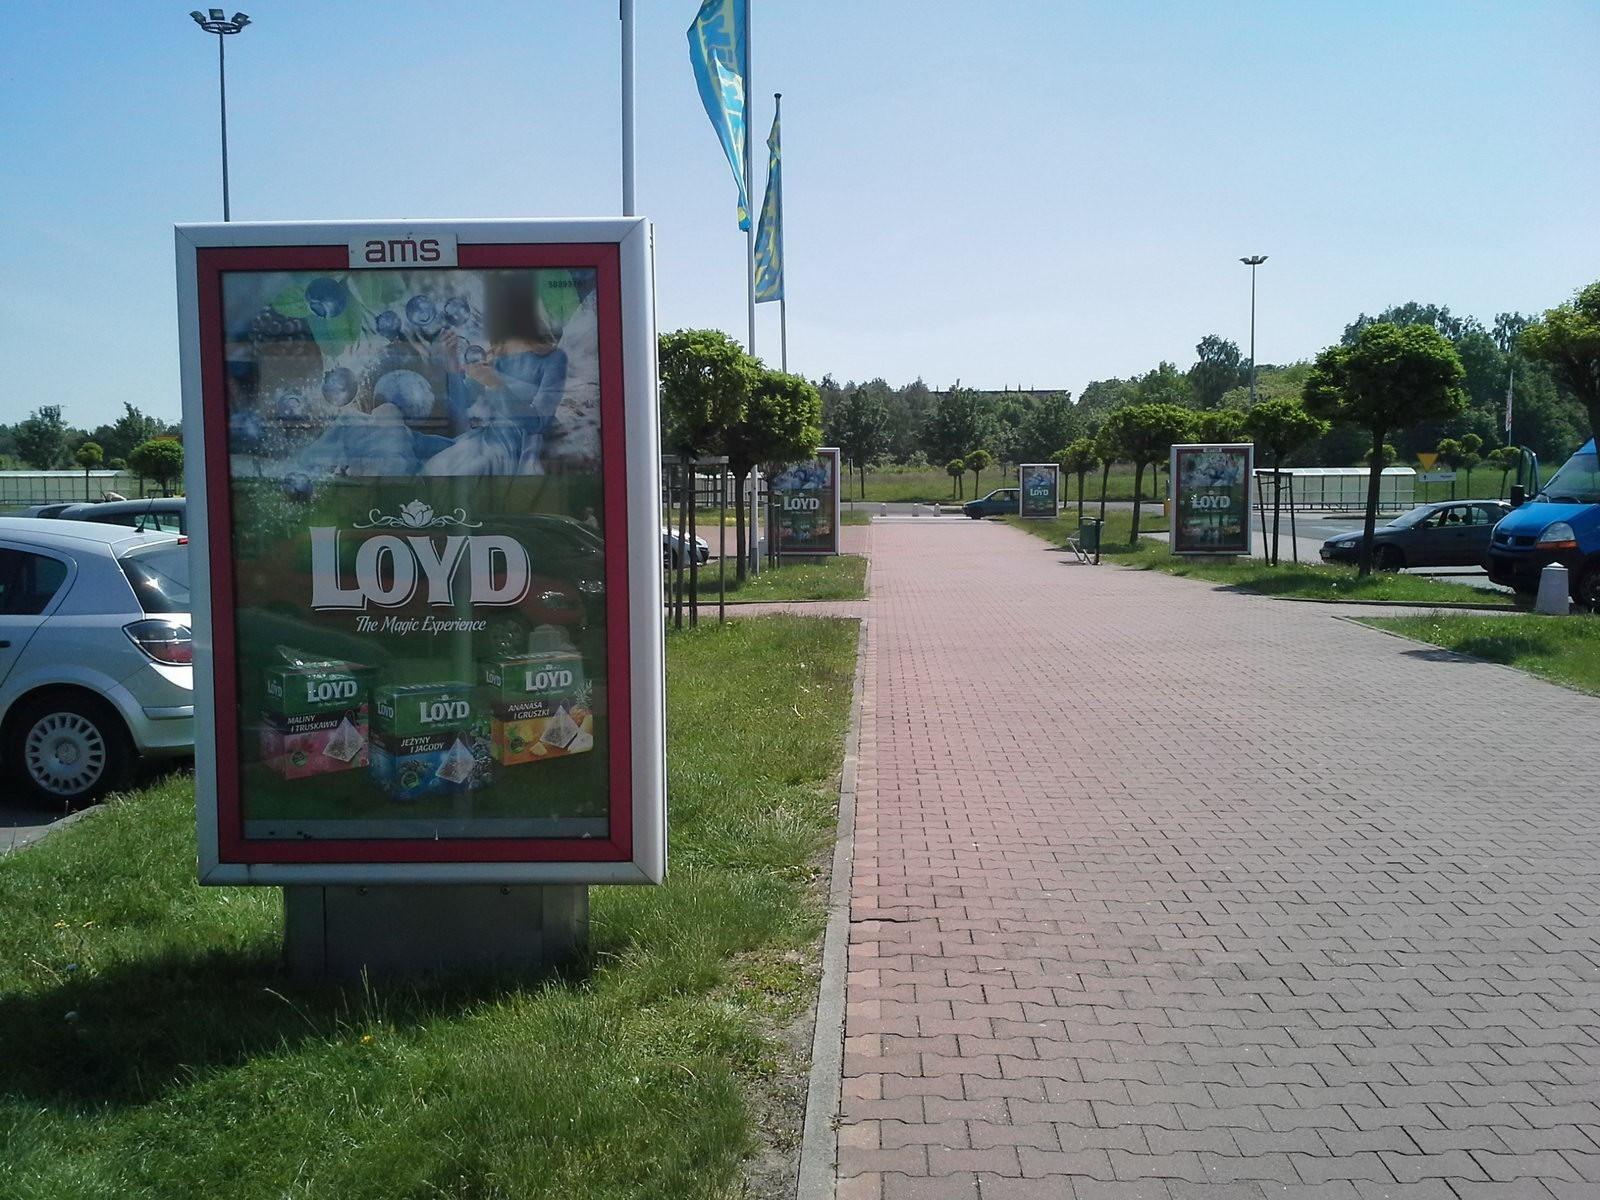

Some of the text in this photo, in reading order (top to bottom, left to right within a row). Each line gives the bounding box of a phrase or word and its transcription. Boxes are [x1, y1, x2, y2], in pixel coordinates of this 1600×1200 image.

[365, 239, 441, 262] ams
[783, 496, 820, 511] LOYD
[1191, 495, 1231, 509] LOYD
[309, 526, 531, 611] LOYD
[356, 615, 487, 636] The Magic Experience
[525, 669, 573, 692] LOYD
[307, 680, 358, 703] LOYD
[420, 700, 470, 723] LOYD
[508, 701, 543, 712] ANANASA
[517, 708, 550, 719] GRUSZKI
[287, 714, 316, 725] MALINY
[295, 720, 338, 732] TRUSKAWKI
[415, 742, 445, 753] JAGODY
